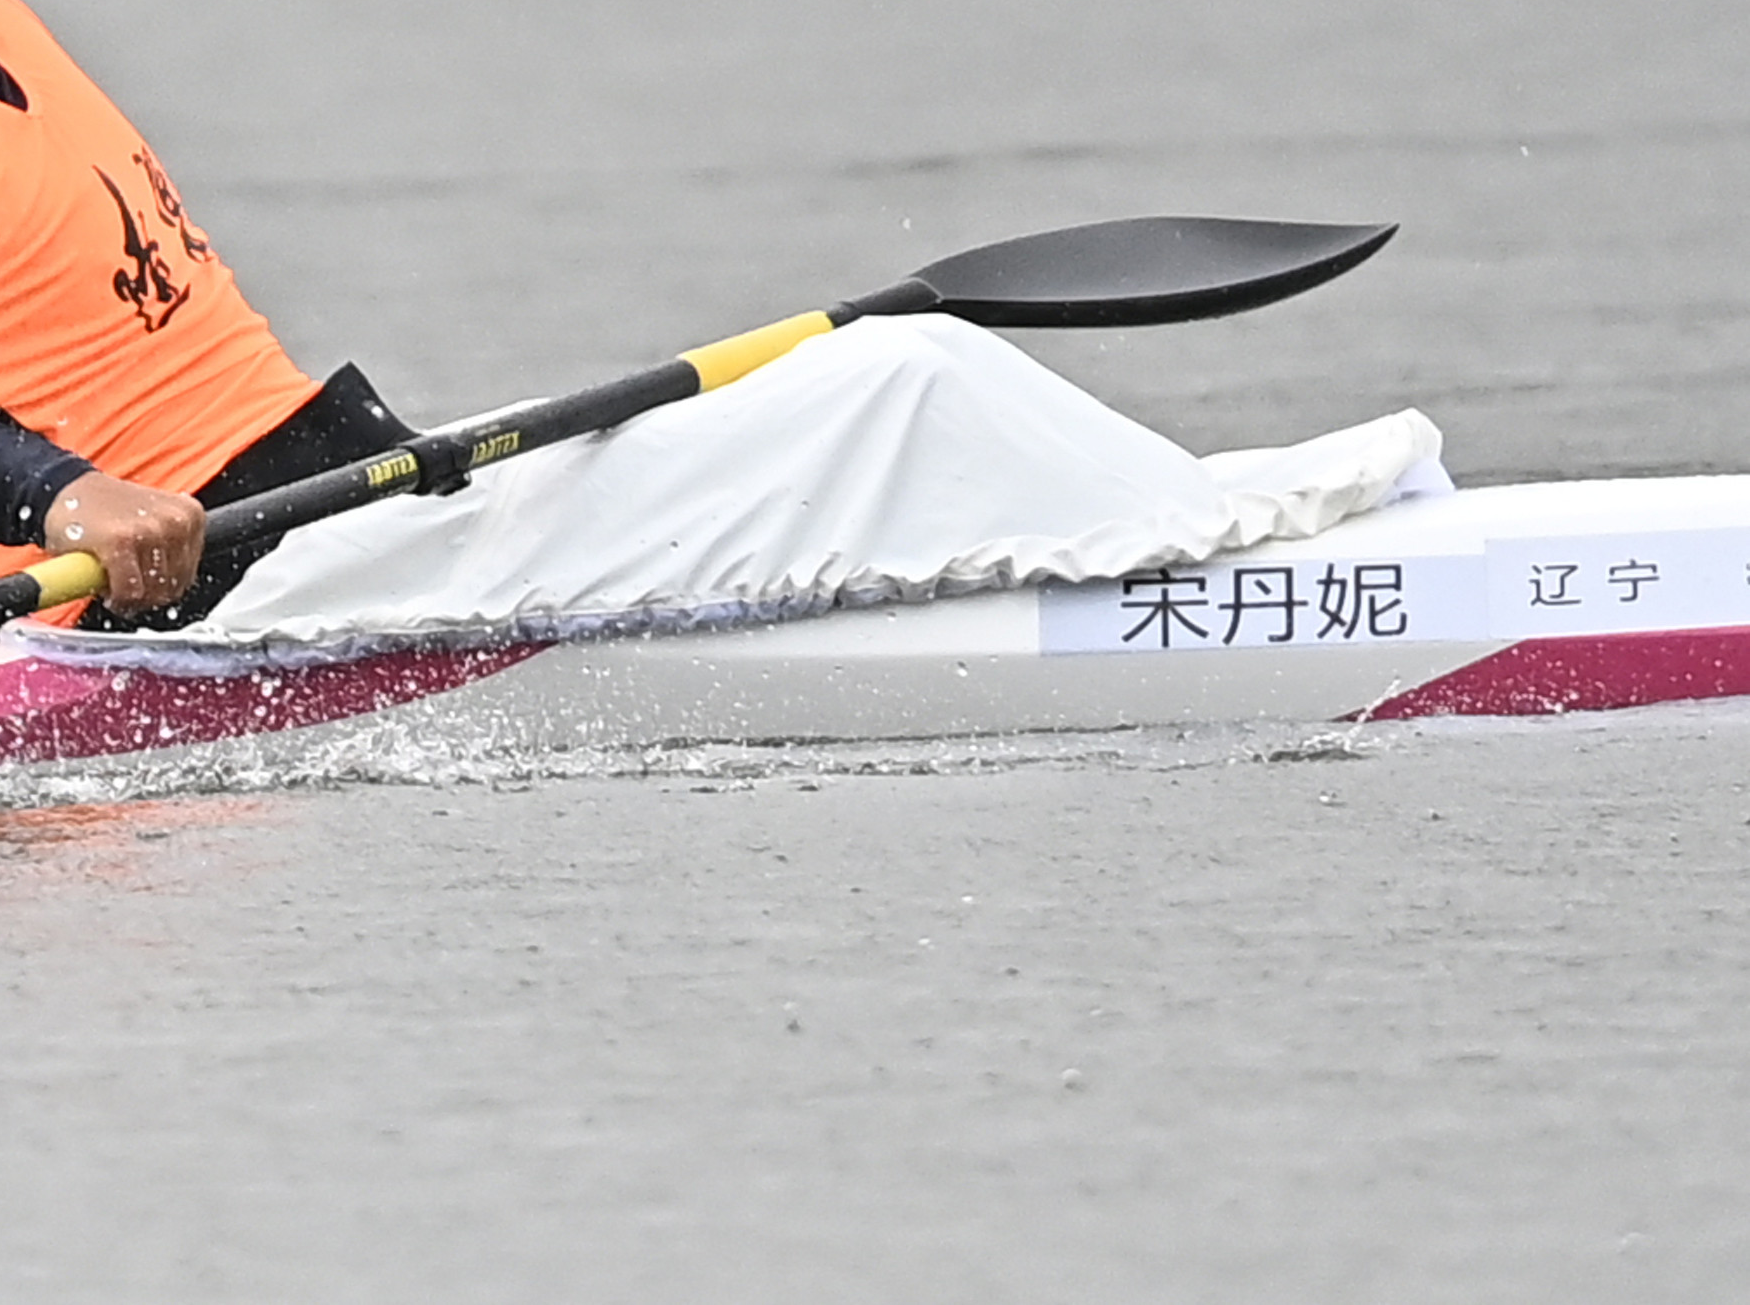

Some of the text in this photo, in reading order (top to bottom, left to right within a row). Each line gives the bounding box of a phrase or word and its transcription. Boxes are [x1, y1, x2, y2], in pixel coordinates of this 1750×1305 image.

[1120, 561, 1408, 648] 宋丹妮
[1528, 558, 1661, 607] 辽宁
